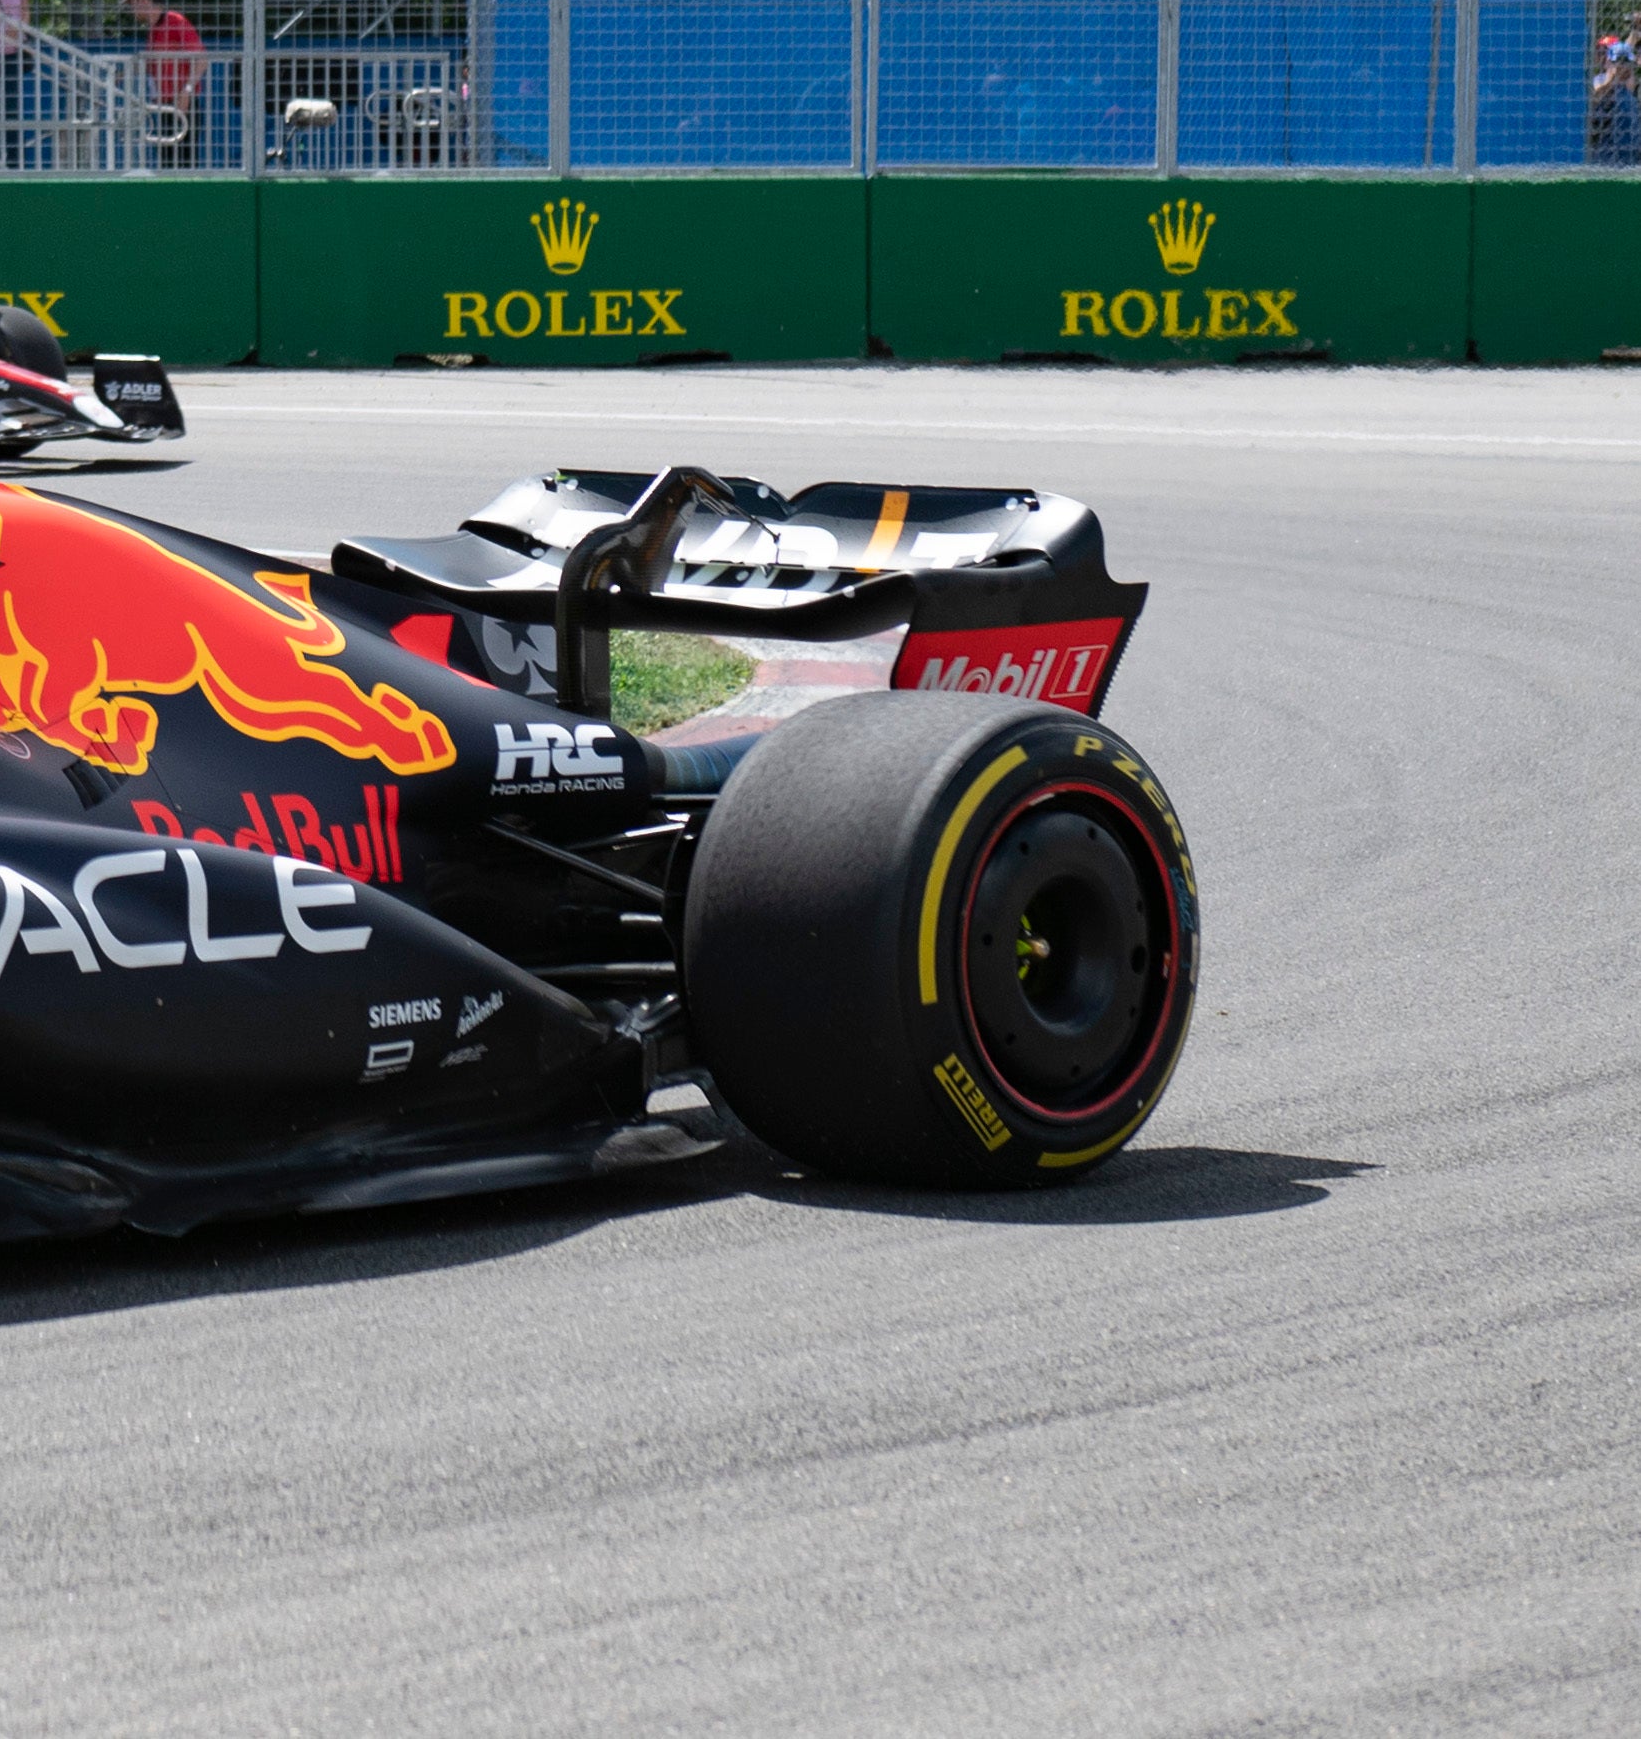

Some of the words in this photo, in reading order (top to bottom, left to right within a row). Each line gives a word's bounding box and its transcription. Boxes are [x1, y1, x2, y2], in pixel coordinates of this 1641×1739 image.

[442, 288, 687, 339] ROLEX
[1059, 288, 1299, 340] ROLEX
[493, 722, 624, 781] HRC
[489, 780, 556, 796] Honda
[557, 776, 626, 793] RACING
[271, 783, 404, 885] Bull
[1073, 735, 1105, 757] P
[1111, 749, 1197, 897] ZERO
[368, 996, 442, 1030] SIEMENS
[932, 1050, 1013, 1152] PIRELLI
